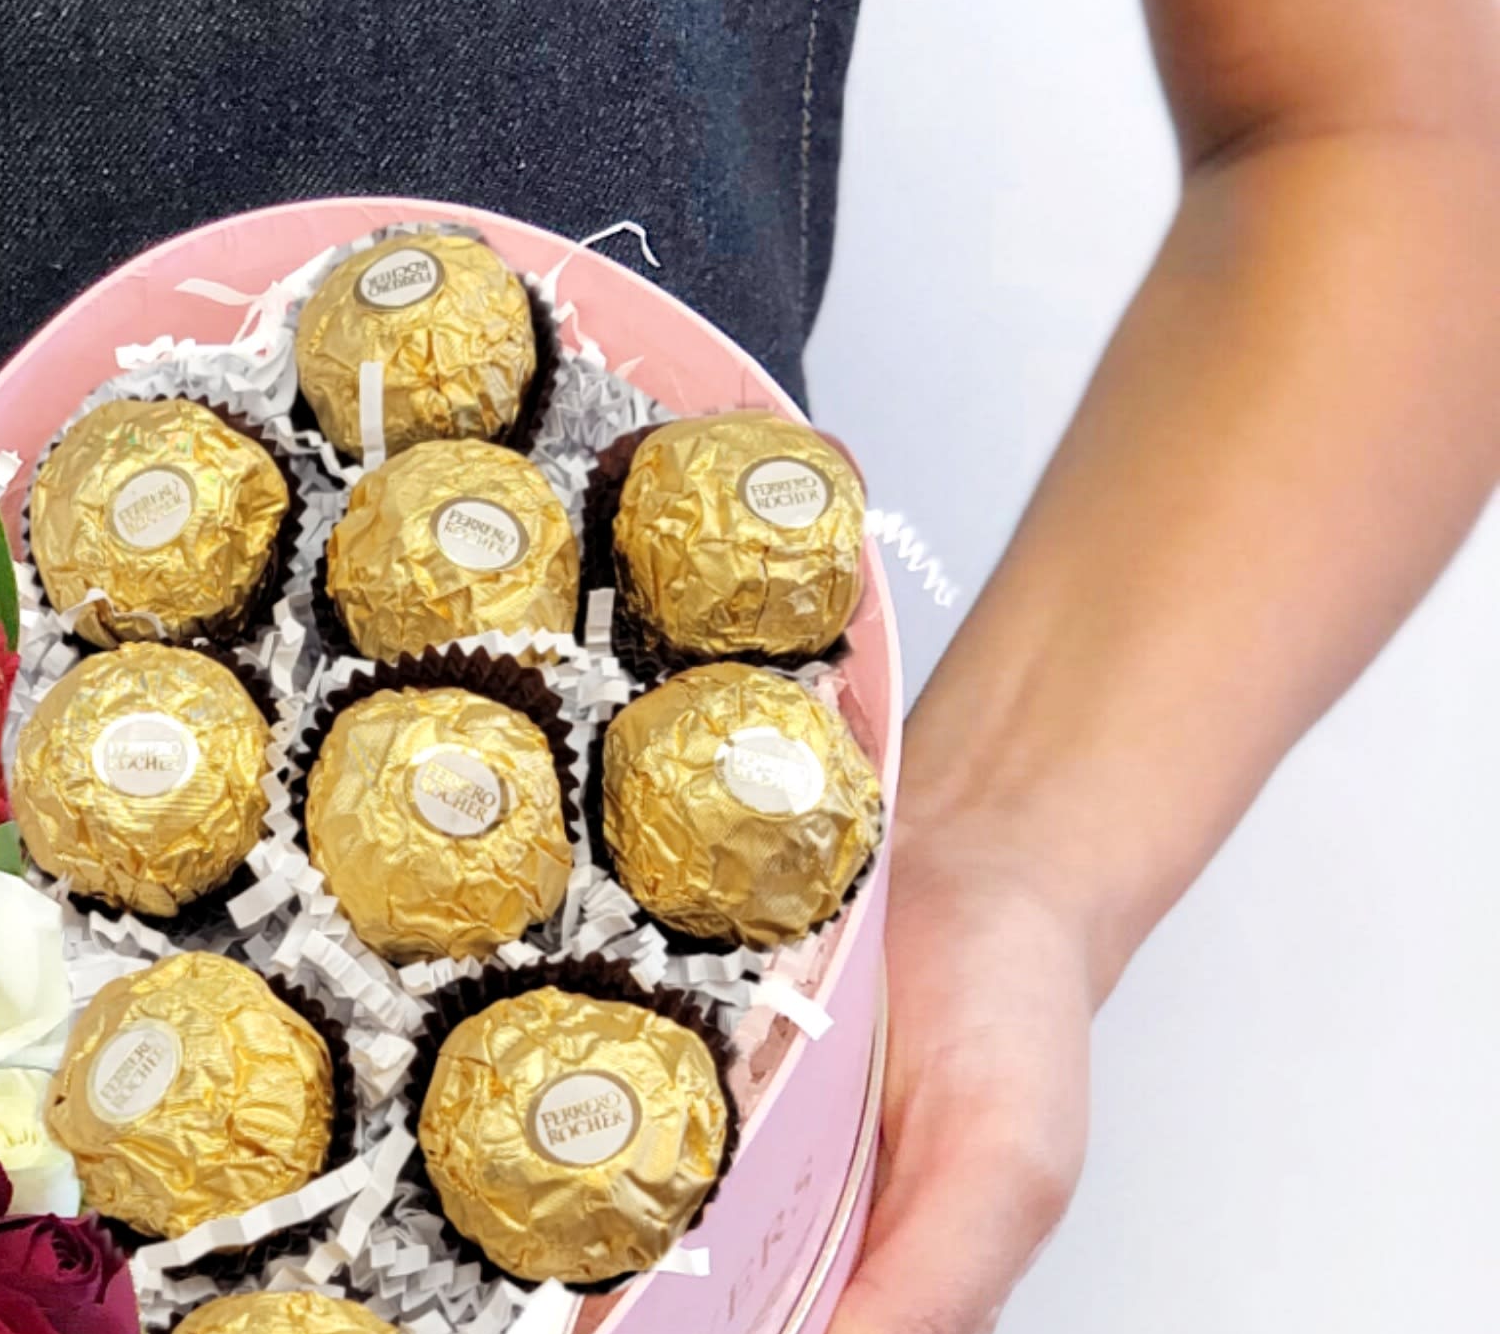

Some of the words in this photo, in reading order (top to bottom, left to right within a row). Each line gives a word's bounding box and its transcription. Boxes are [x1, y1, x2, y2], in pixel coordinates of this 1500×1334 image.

[750, 475, 817, 497] FERRERO
[755, 489, 819, 510] ROCHER
[448, 508, 516, 547] FERRERO
[541, 1091, 621, 1130] FERRERO
[547, 1110, 626, 1146] ROCHER
